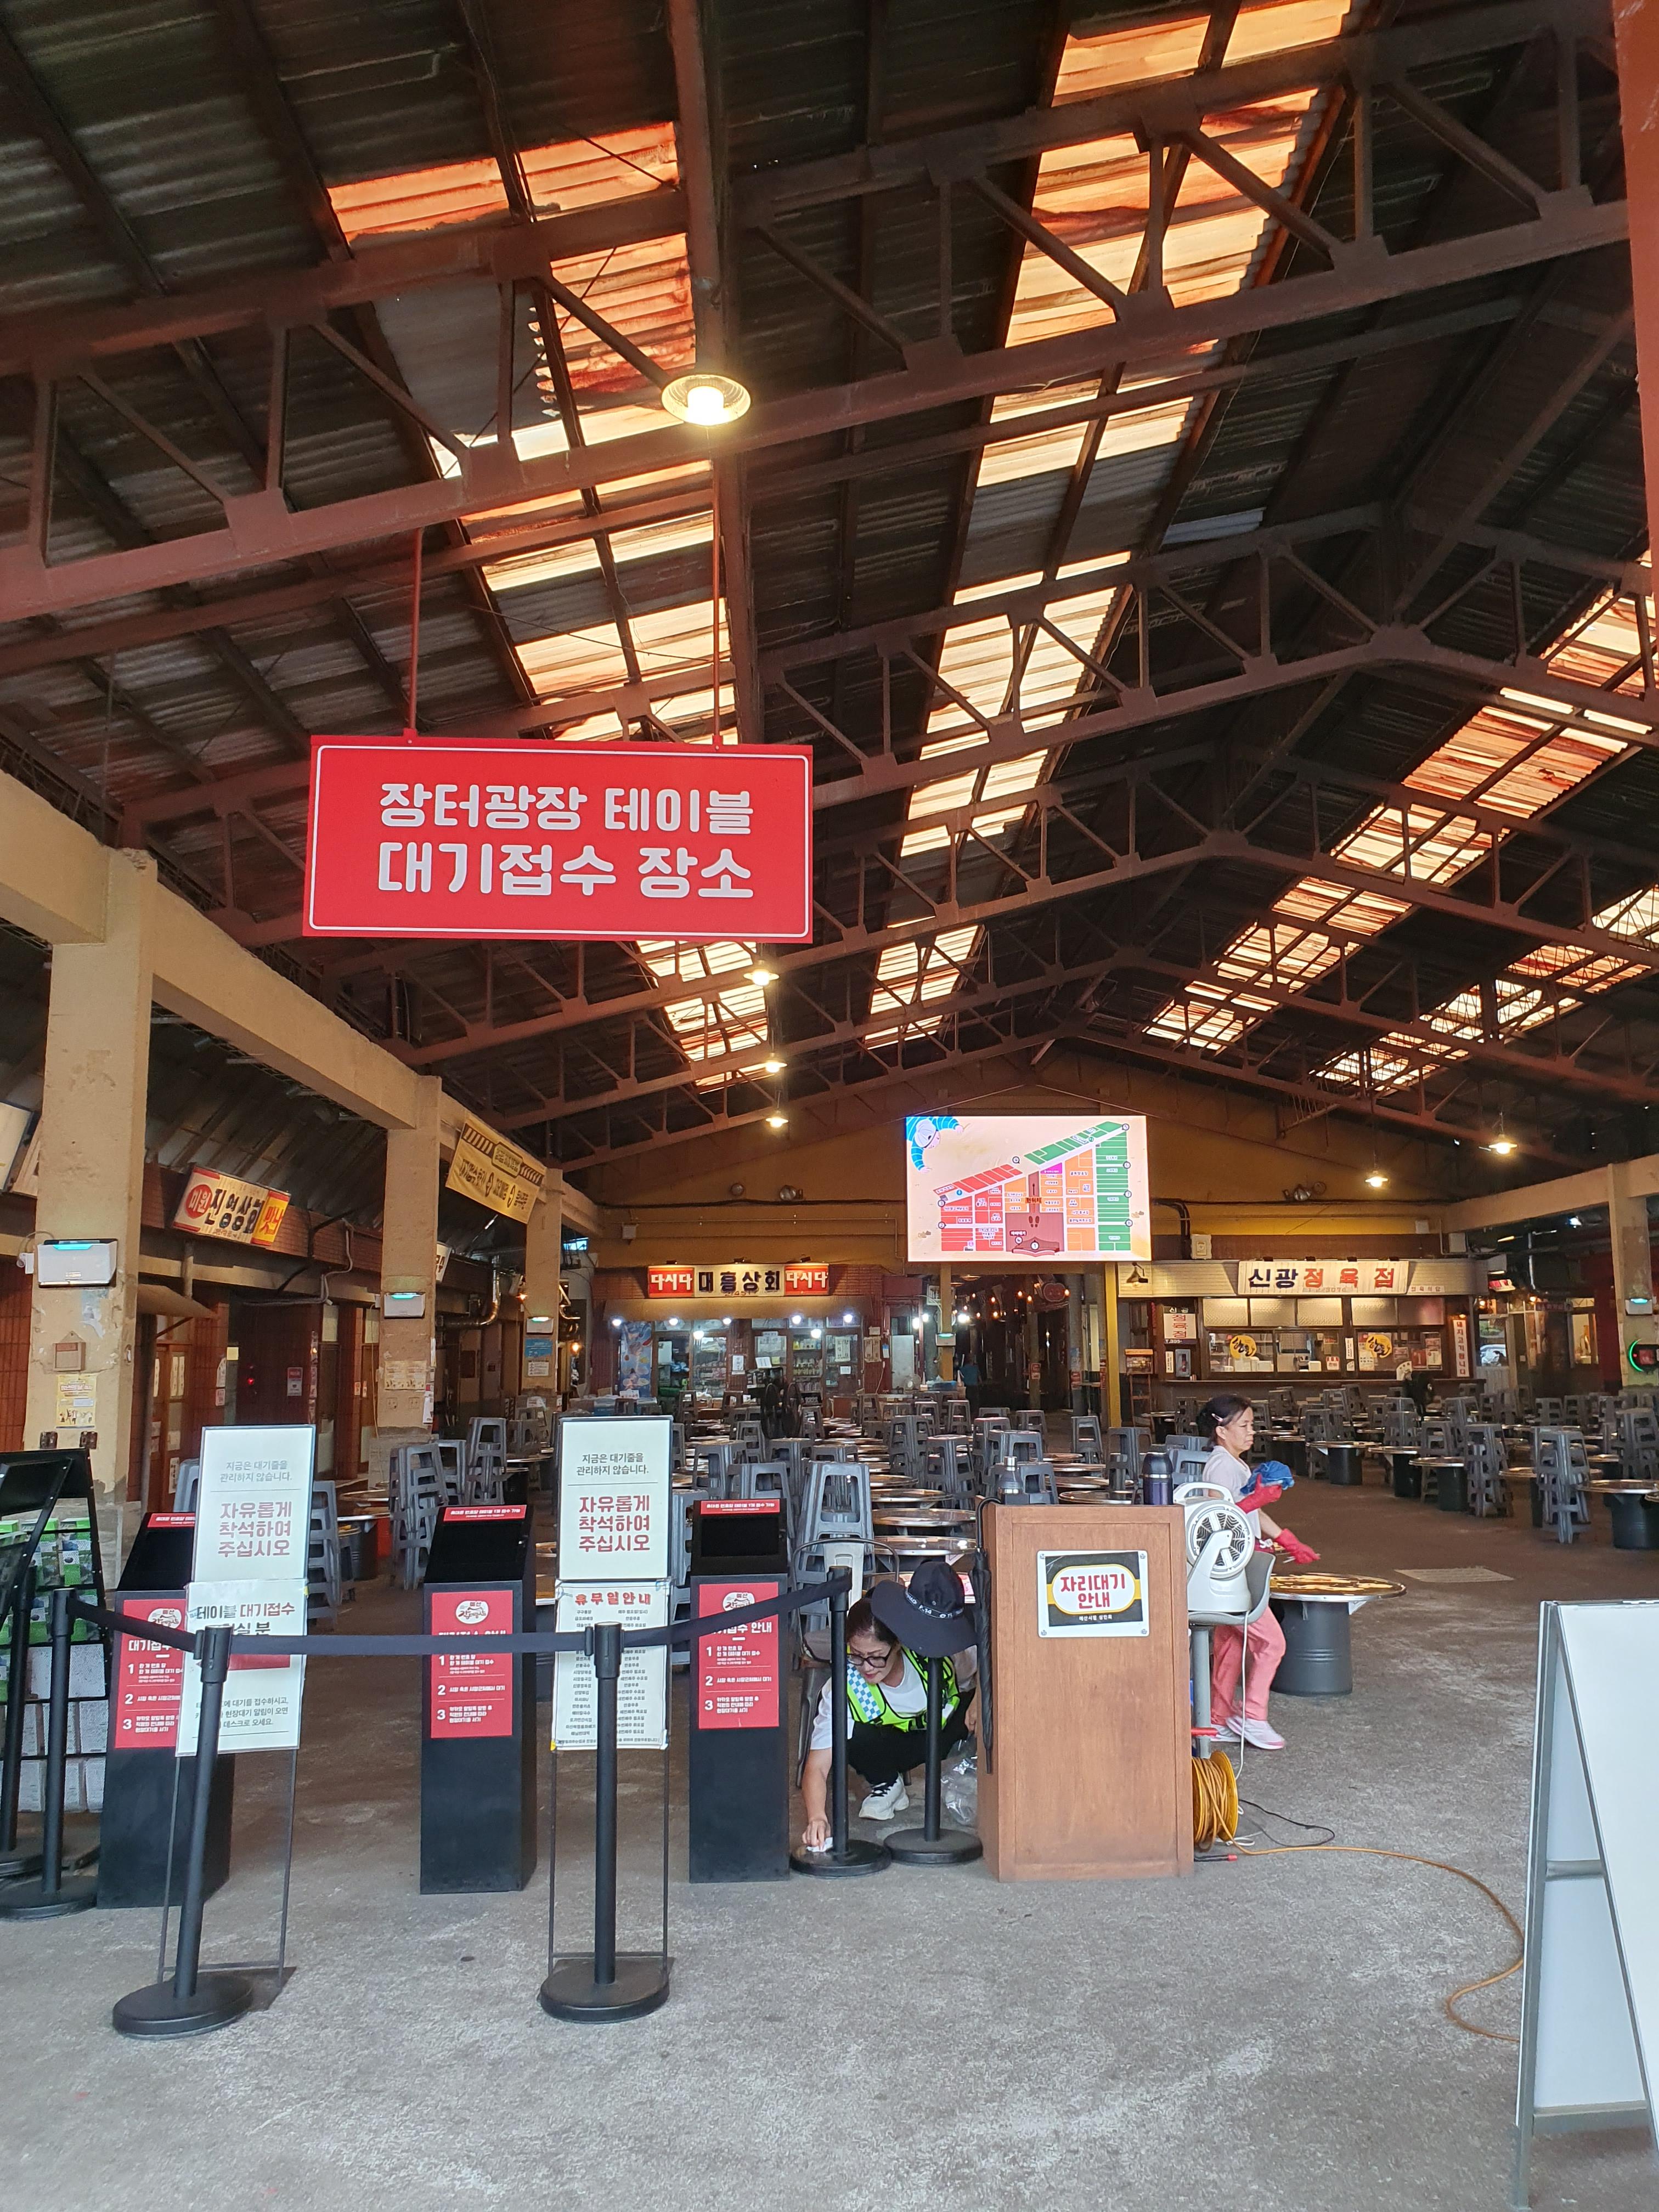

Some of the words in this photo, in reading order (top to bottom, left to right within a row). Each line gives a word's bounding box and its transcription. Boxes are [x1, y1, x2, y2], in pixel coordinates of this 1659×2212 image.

[379, 782, 588, 831] 장터광장
[605, 787, 754, 836] 테이블
[377, 841, 617, 896] 대기접수
[637, 847, 754, 899] 장소
[188, 1189, 211, 1214] 미원
[651, 1273, 692, 1291] 다시다
[698, 1270, 780, 1293] 대흥상회
[786, 1271, 828, 1289] 다시다
[582, 1454, 608, 1464] 지금은
[610, 1453, 644, 1463] 대기줄을
[226, 1461, 252, 1471] 지금은
[253, 1460, 287, 1470] 대기줄을
[577, 1465, 610, 1476] 관리하지
[613, 1464, 649, 1475] 않습니다.
[220, 1472, 253, 1483] 관리하지
[256, 1471, 292, 1482] 않습니다.
[220, 1501, 292, 1519] 자유롭게
[579, 1495, 650, 1513] 자유롭게
[219, 1520, 291, 1538] 착석하여
[579, 1515, 650, 1533] 착석하여
[218, 1539, 290, 1558] 주십시오
[579, 1534, 650, 1553] 주십시오
[1060, 1573, 1125, 1592] 자리대기
[1078, 1592, 1110, 1609] 안내
[196, 1605, 237, 1620] 테이블
[240, 1602, 295, 1617] 대기접수
[751, 1622, 772, 1633] 안내
[706, 1646, 712, 1657] 1
[439, 1655, 445, 1666] 1
[128, 1663, 134, 1674] 1
[705, 1675, 713, 1686] 2
[437, 1685, 446, 1695] 2
[125, 1693, 134, 1705] 2
[704, 1700, 713, 1711] 3
[225, 1709, 252, 1718] 현장대기
[253, 1708, 273, 1717] 알림이
[275, 1707, 288, 1715] 오면
[437, 1709, 446, 1720] 3
[122, 1718, 132, 1730] 3
[223, 1719, 250, 1728] 데스크로
[252, 1718, 273, 1726] 오세요.
